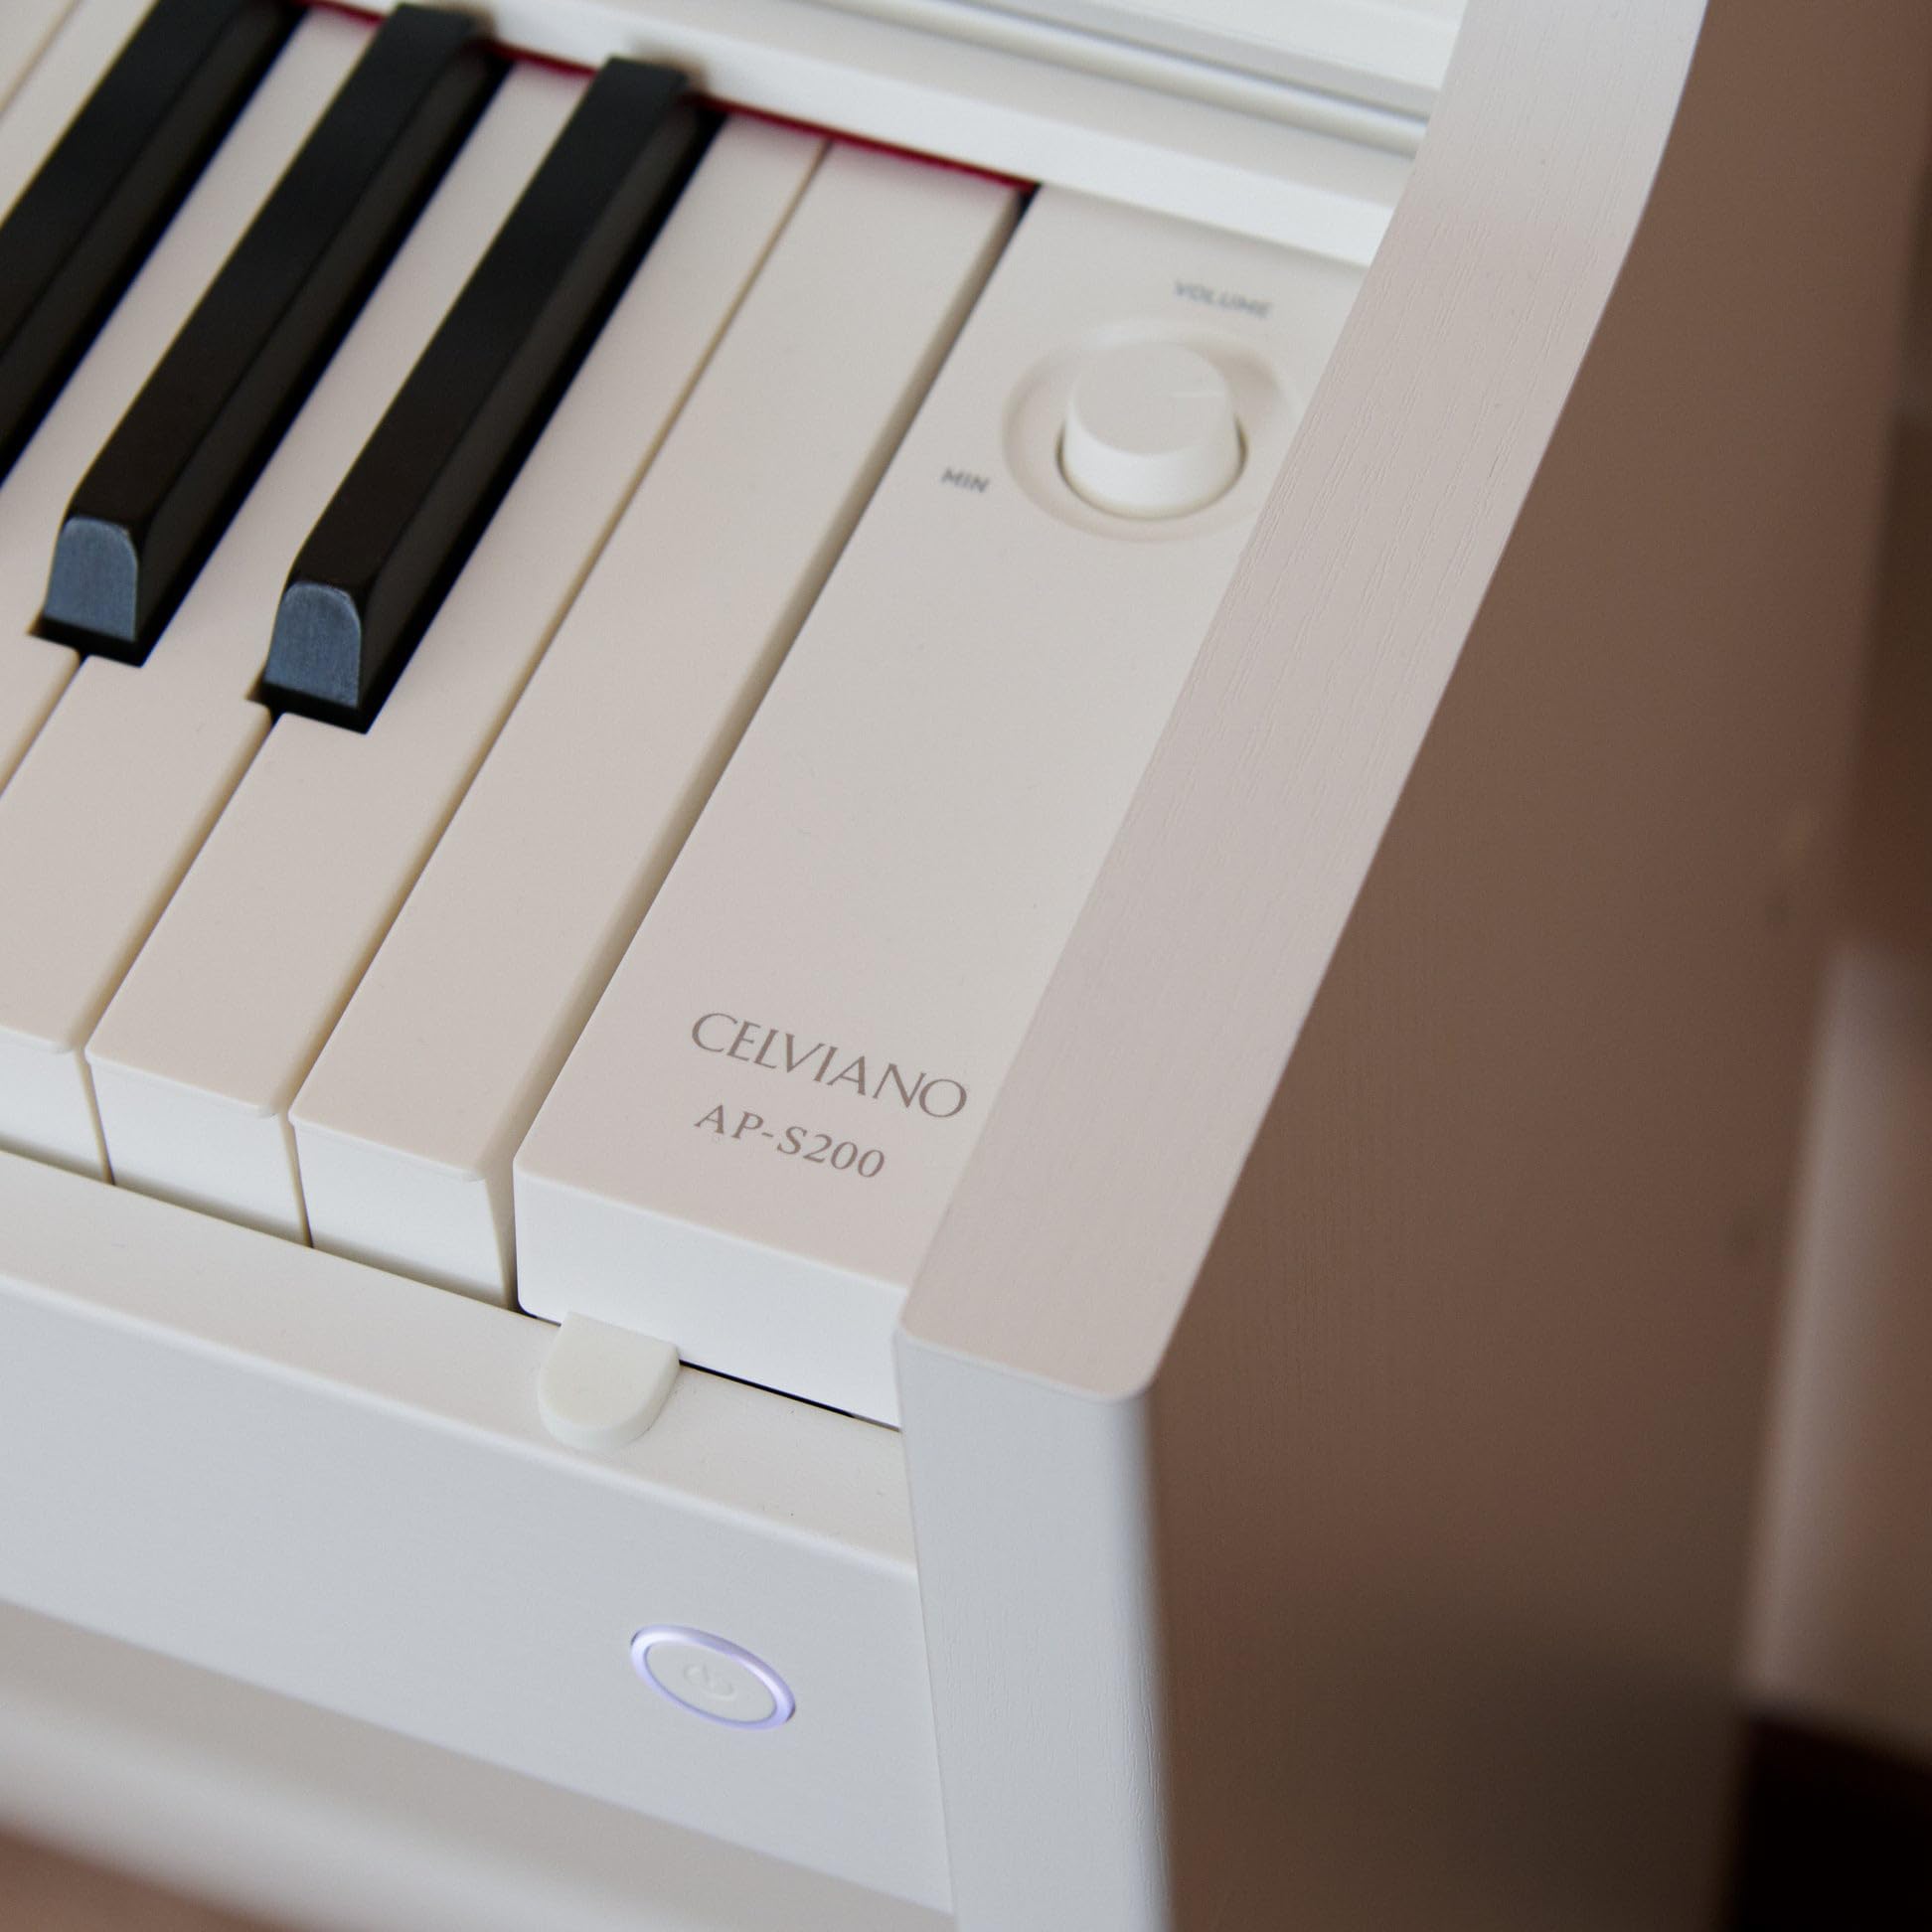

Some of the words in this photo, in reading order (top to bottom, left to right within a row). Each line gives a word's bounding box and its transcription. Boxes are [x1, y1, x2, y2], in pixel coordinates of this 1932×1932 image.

[1174, 280, 1272, 319] VOLUME
[940, 467, 990, 494] MIN
[692, 1013, 968, 1118] CELVIANO
[694, 1104, 886, 1178] AP-S200
